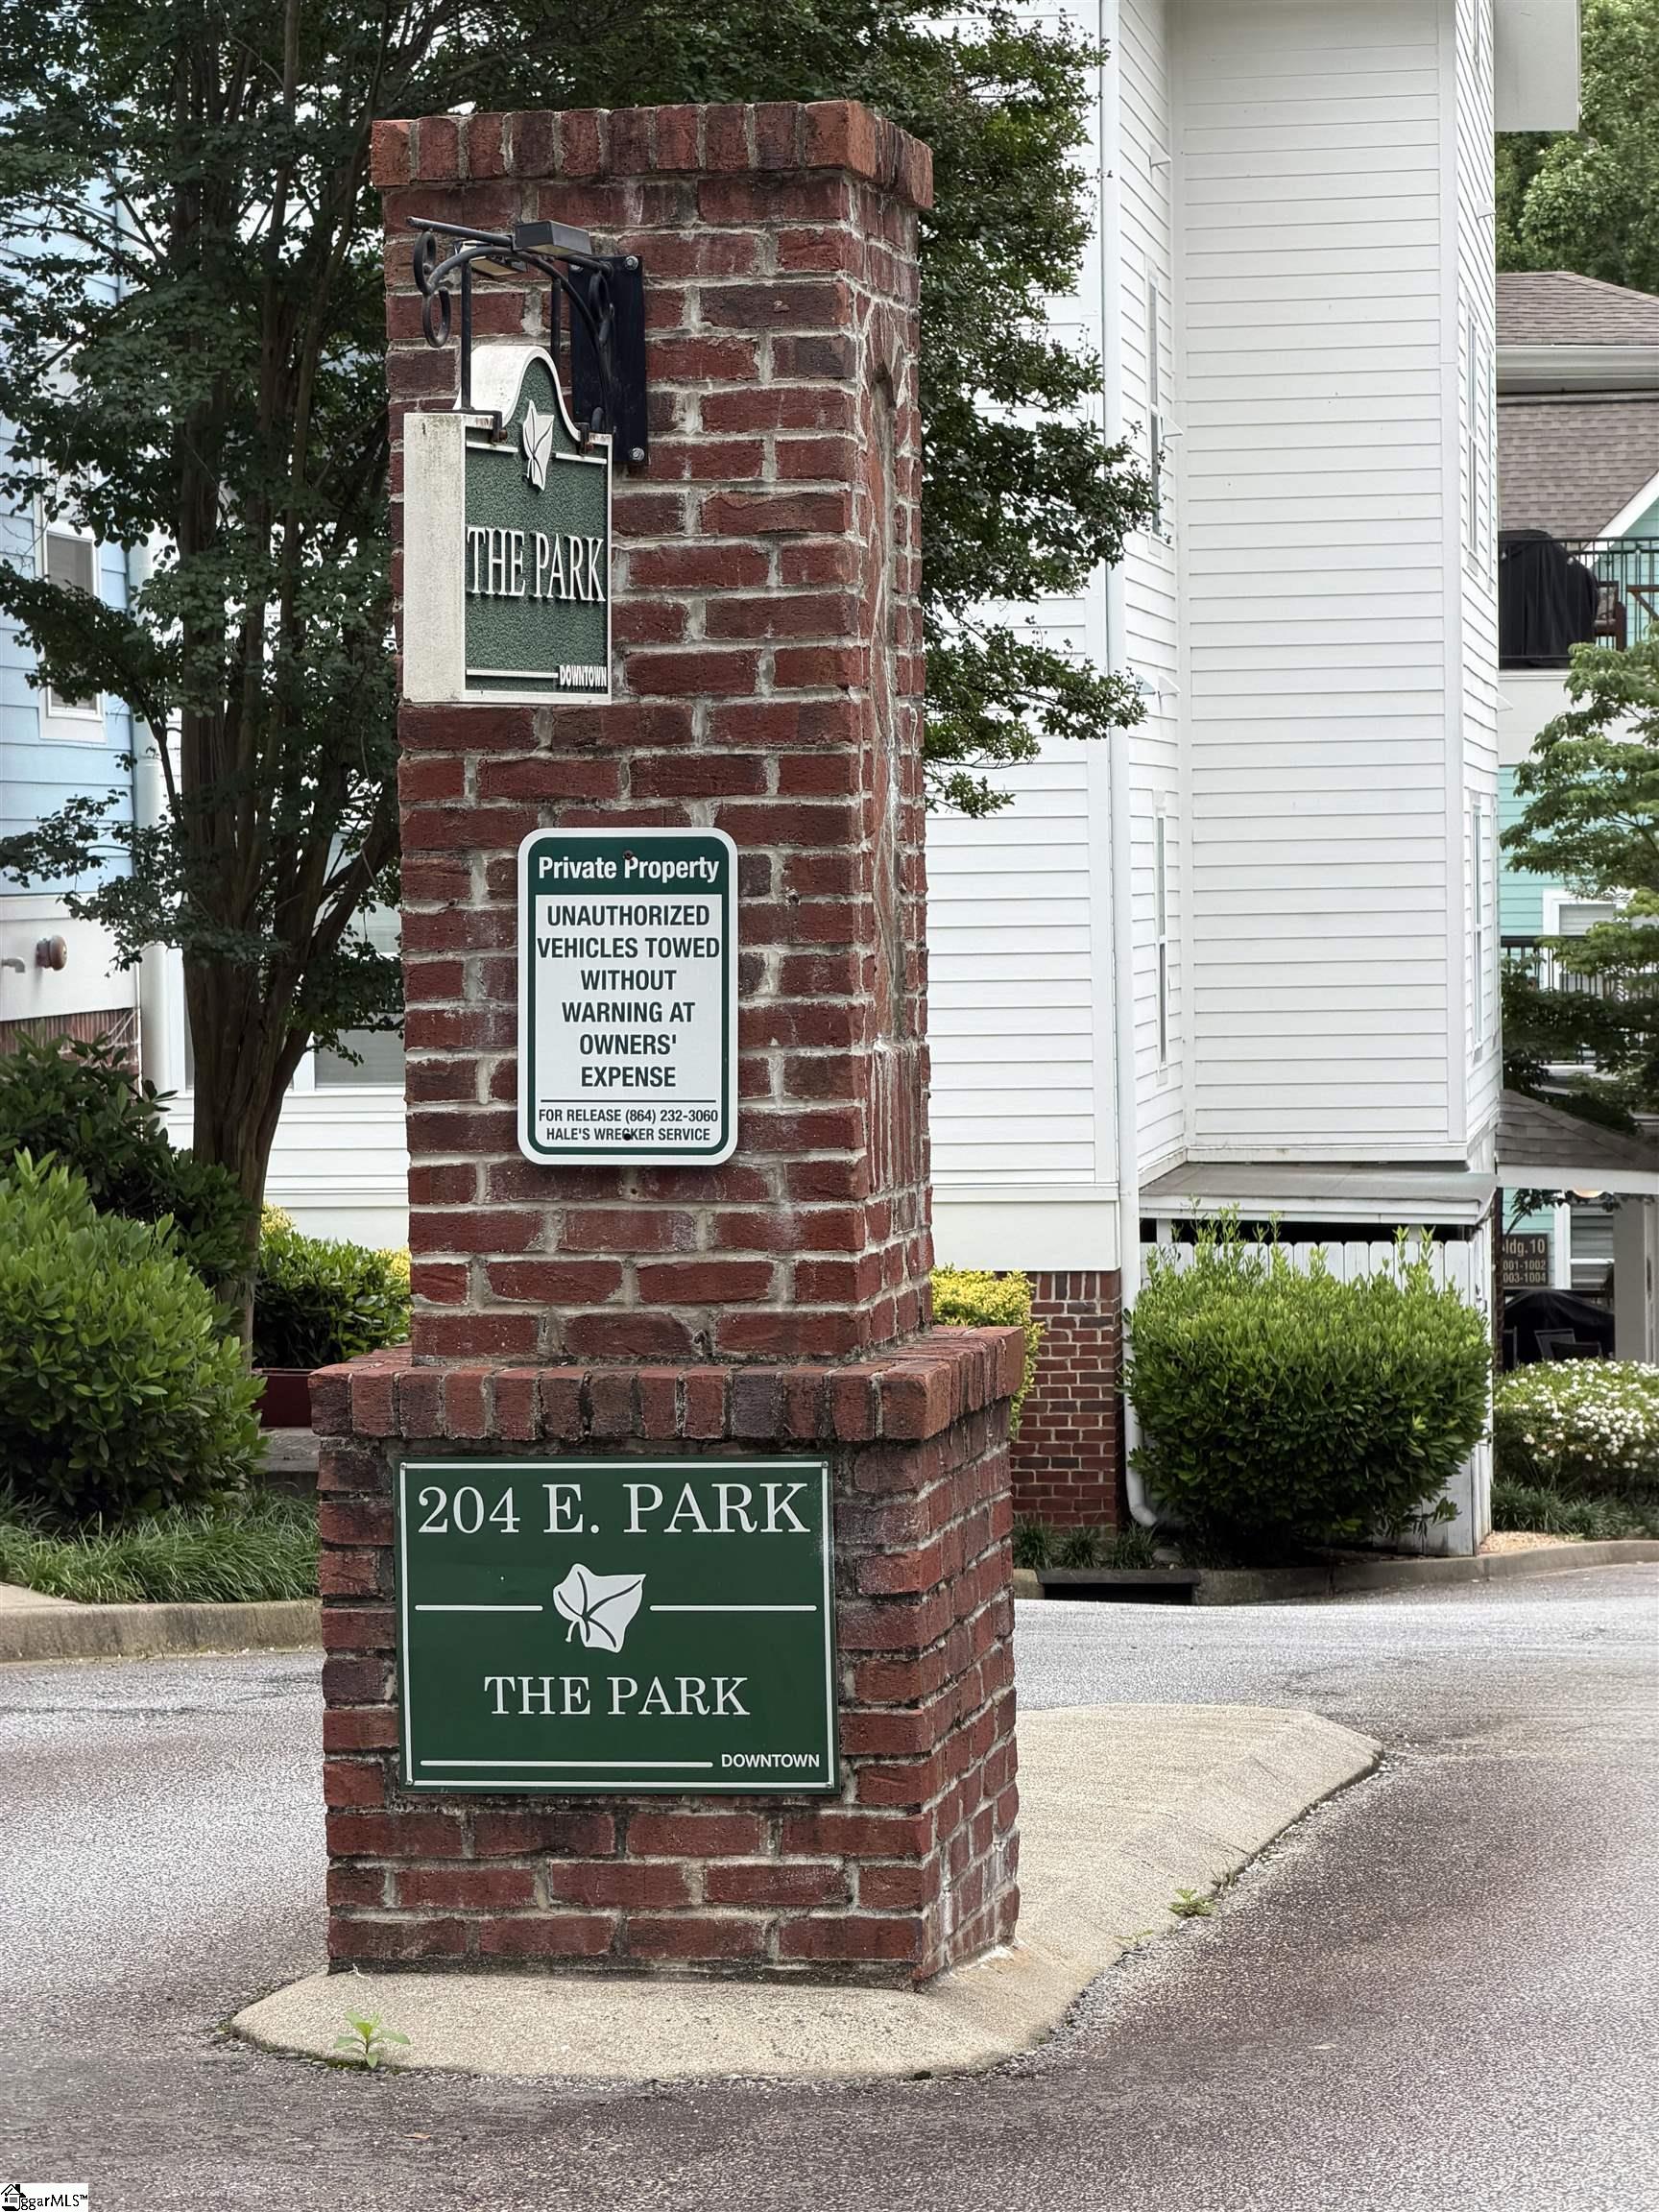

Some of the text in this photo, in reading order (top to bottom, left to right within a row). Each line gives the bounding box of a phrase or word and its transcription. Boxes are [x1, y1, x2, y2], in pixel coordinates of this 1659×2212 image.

[467, 526, 605, 602] THE PARK
[559, 665, 607, 687] DOWNTOWN
[539, 856, 719, 883] Private Property
[546, 905, 709, 926] UNAUTHORIZED
[537, 938, 719, 958] VEHICLES TOWED
[581, 970, 677, 990] WITHOUT
[562, 1002, 695, 1022] WARNING AT
[579, 1034, 677, 1055] OWNERS'
[581, 1067, 676, 1087] EXPENSE
[539, 1110, 718, 1123] FOR RELEASE (864) 232-3060
[546, 1127, 710, 1141] HALE'S WRECKER SERVICE
[1503, 1238, 1546, 1257] ldg. 10
[1503, 1260, 1547, 1271] 001-1002
[1503, 1272, 1547, 1284] 003-1004
[418, 1482, 811, 1534] 204 E. PARK
[484, 1676, 751, 1716] THE PARK
[721, 1754, 821, 1768] DOWNTOWN
